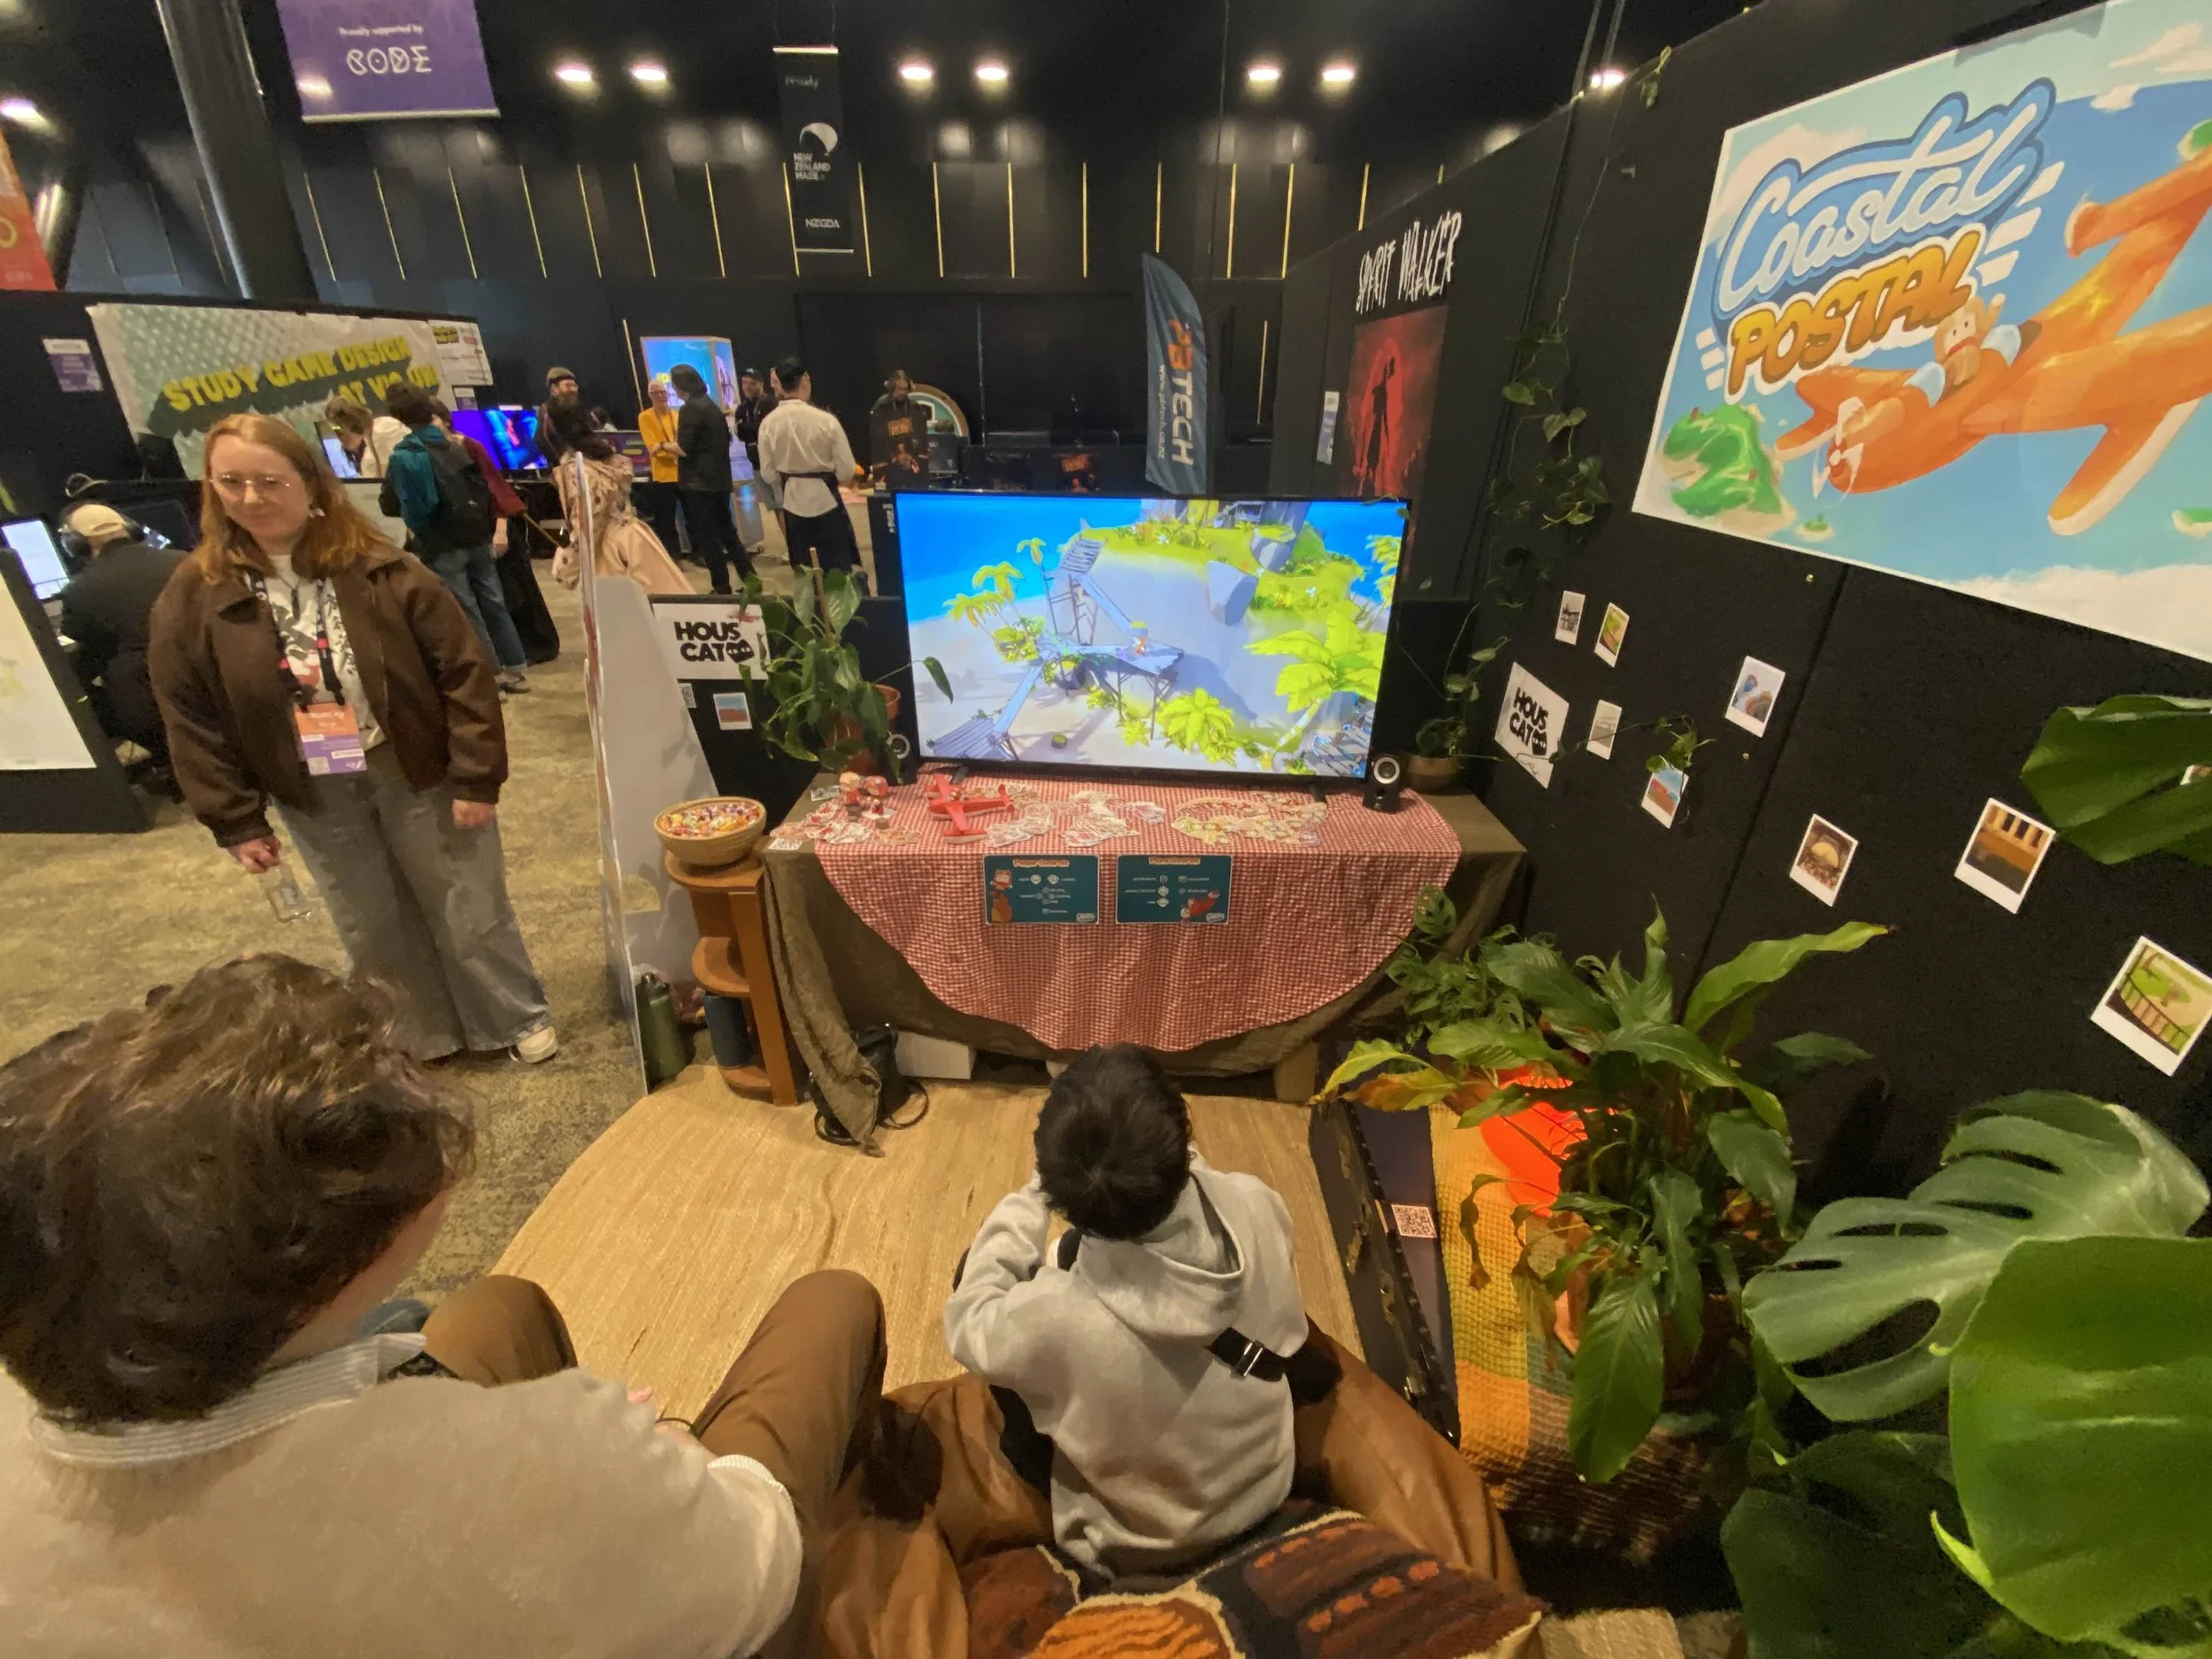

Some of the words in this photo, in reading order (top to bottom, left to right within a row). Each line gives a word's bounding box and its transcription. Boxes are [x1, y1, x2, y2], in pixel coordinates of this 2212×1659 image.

[346, 45, 433, 76] CODE
[794, 152, 812, 162] NEW
[1719, 103, 2038, 312] Coastal
[1398, 211, 1462, 303] WALKER
[1727, 229, 1985, 396] POSTAL
[1167, 319, 1193, 371] PB
[162, 364, 258, 412] STUDY
[265, 348, 338, 388] GAME
[335, 335, 411, 373] DESIGN
[1171, 372, 1194, 466] TECH
[673, 621, 741, 641] HOUS
[680, 642, 726, 662] CAT
[1509, 711, 1534, 747] CAT
[1513, 686, 1549, 731] HOUS
